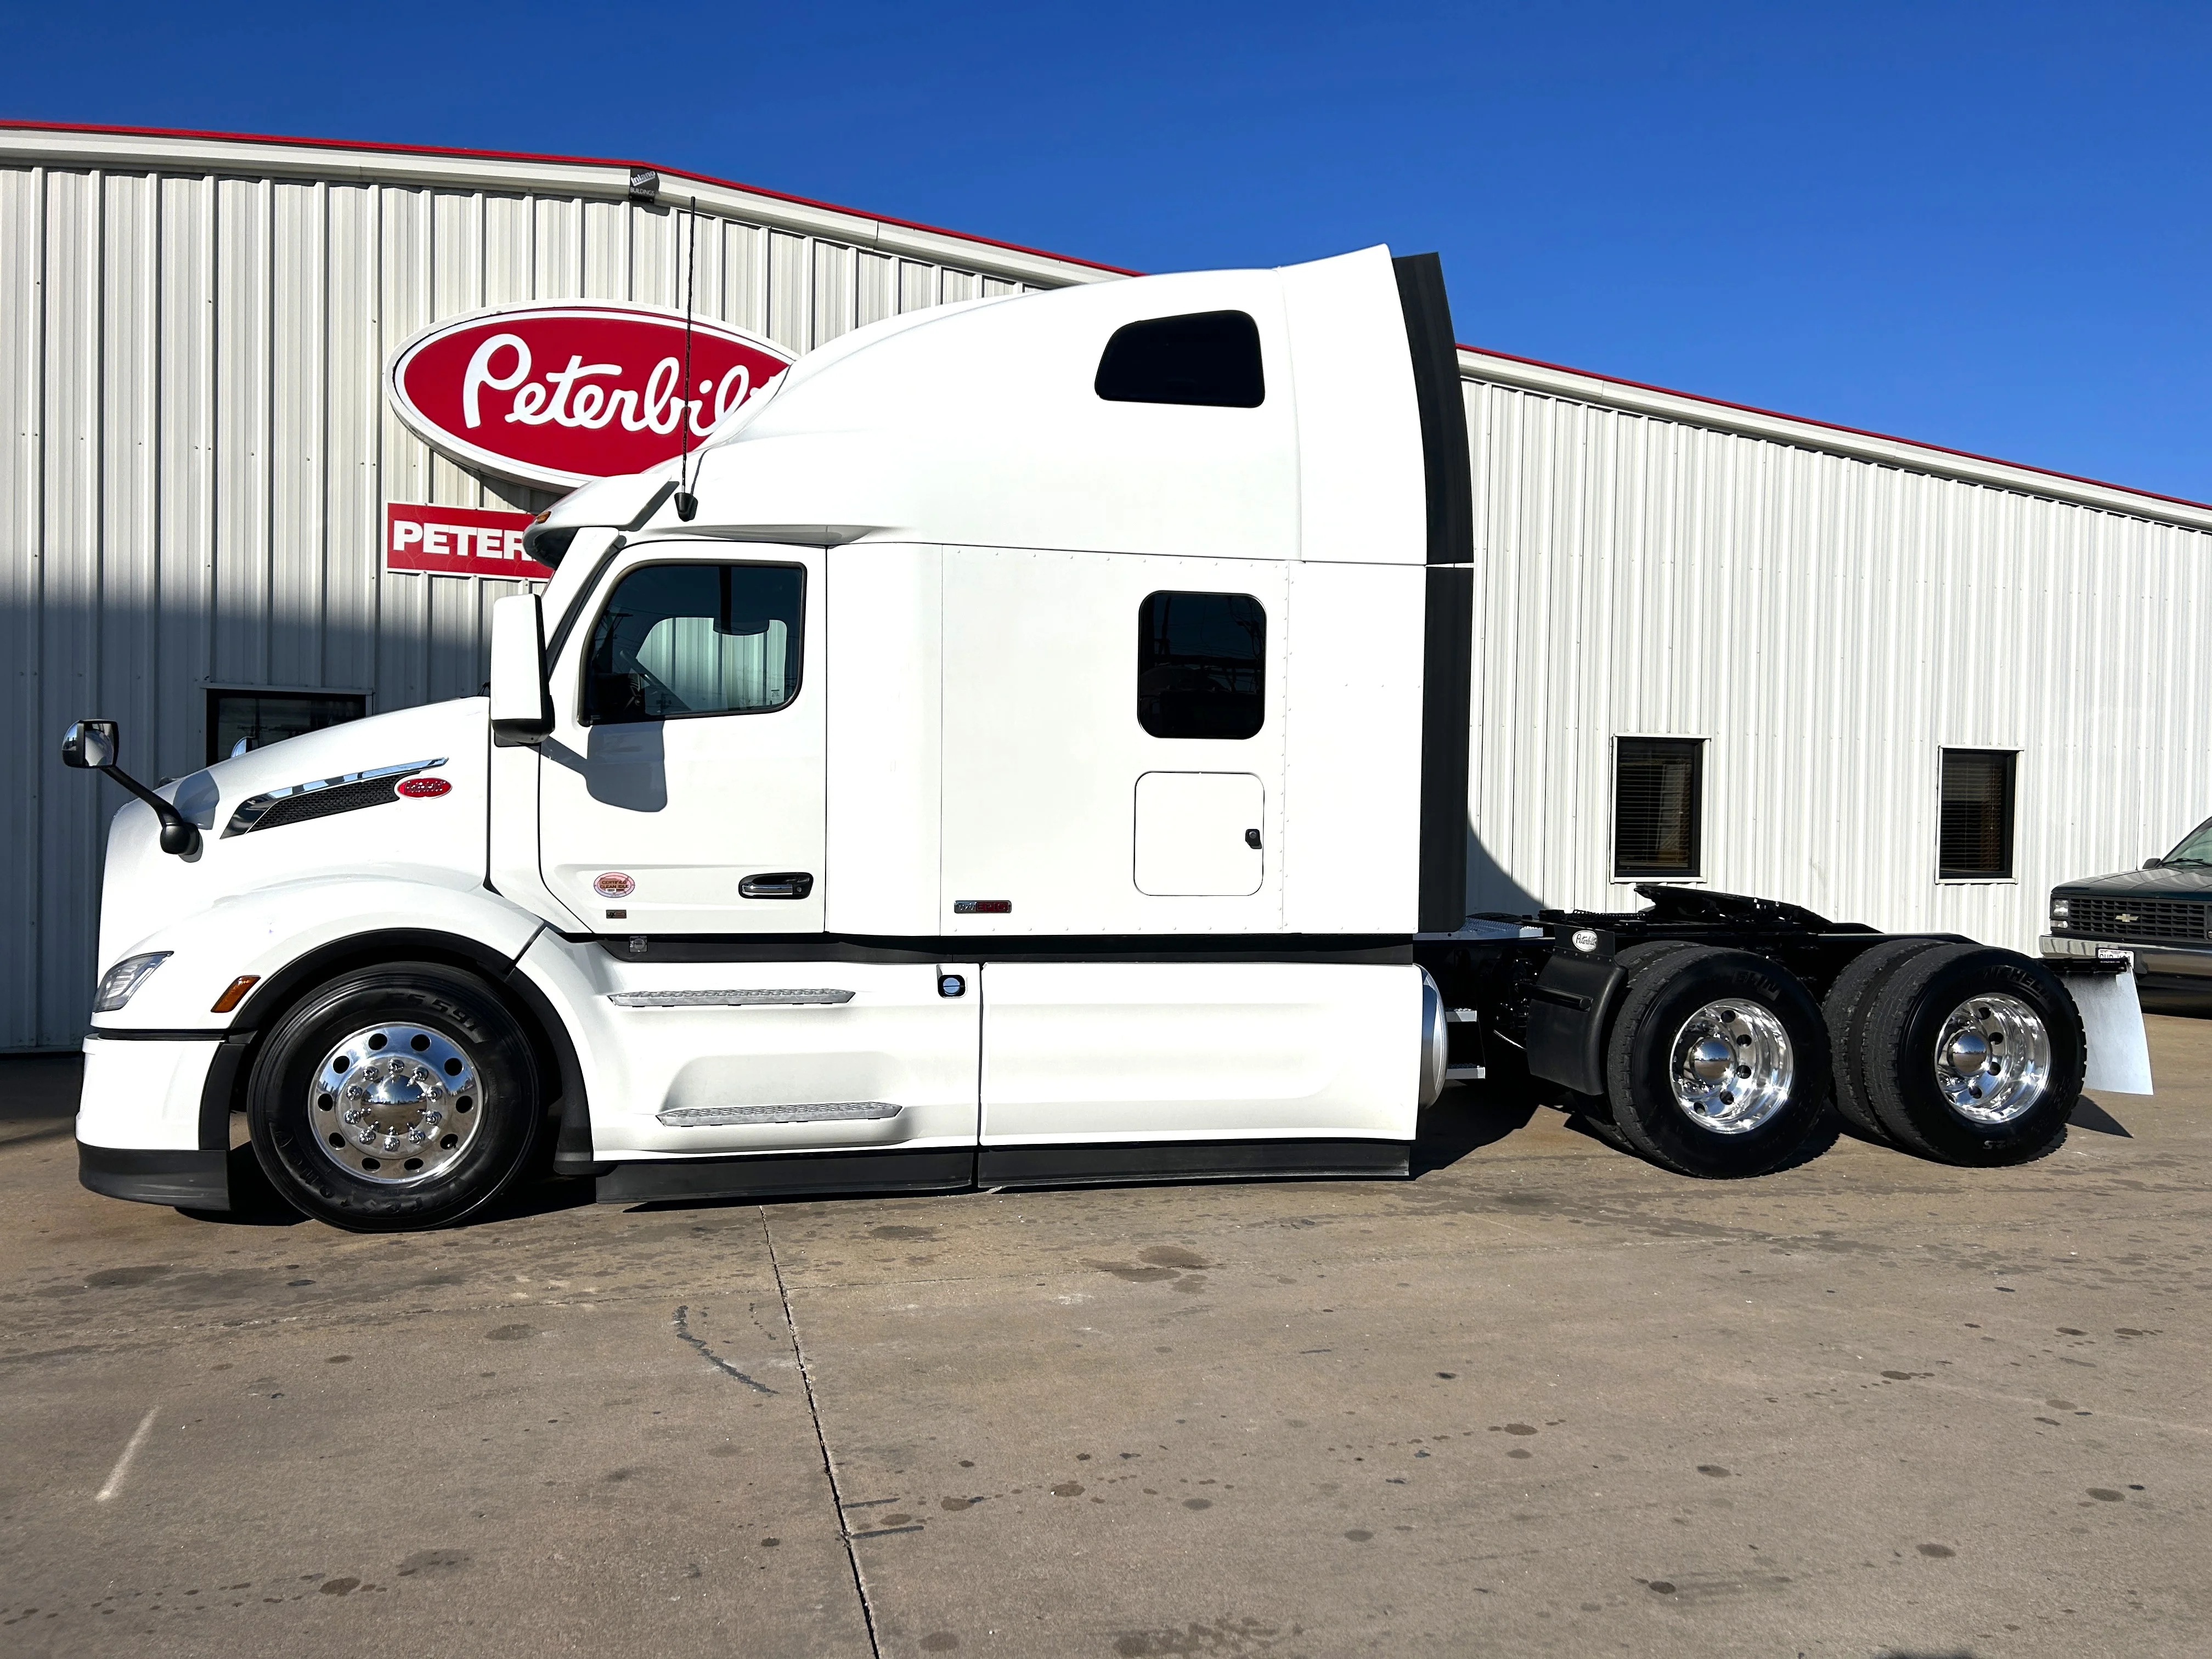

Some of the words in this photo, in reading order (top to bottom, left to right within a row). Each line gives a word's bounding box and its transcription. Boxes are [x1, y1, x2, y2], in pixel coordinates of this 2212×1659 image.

[630, 187, 655, 196] BUILDINGS
[463, 333, 764, 437] Peterbil
[393, 520, 536, 561] PETER
